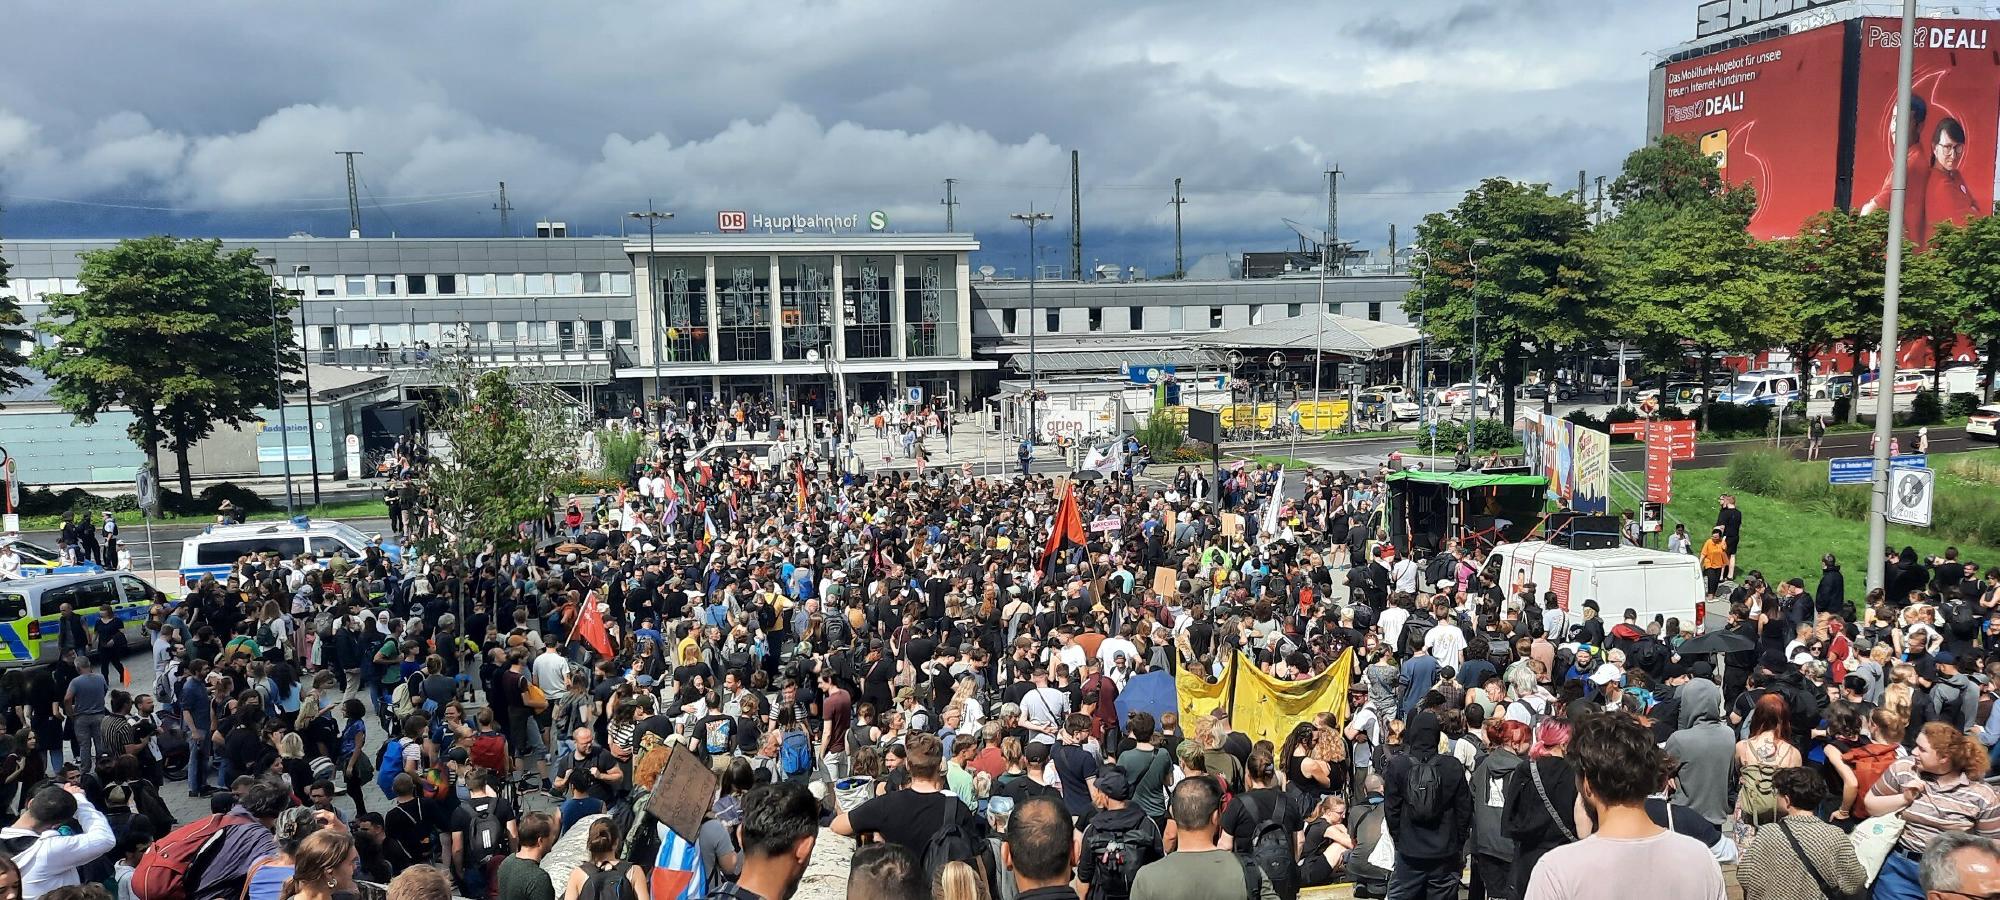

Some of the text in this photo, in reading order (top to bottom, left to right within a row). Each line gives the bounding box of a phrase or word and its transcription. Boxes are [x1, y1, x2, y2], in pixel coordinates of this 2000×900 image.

[1869, 26, 1986, 49] Past? DEAL!
[1668, 50, 1781, 84] Das Mobilfunk-Angebot für unsere
[1668, 86, 1689, 98] treuen
[1667, 91, 1744, 123] Passt? DEAL!
[722, 214, 743, 227] DB
[752, 214, 858, 230] Hauptbahnhof
[870, 211, 886, 230] S
[262, 423, 308, 432] Radsation
